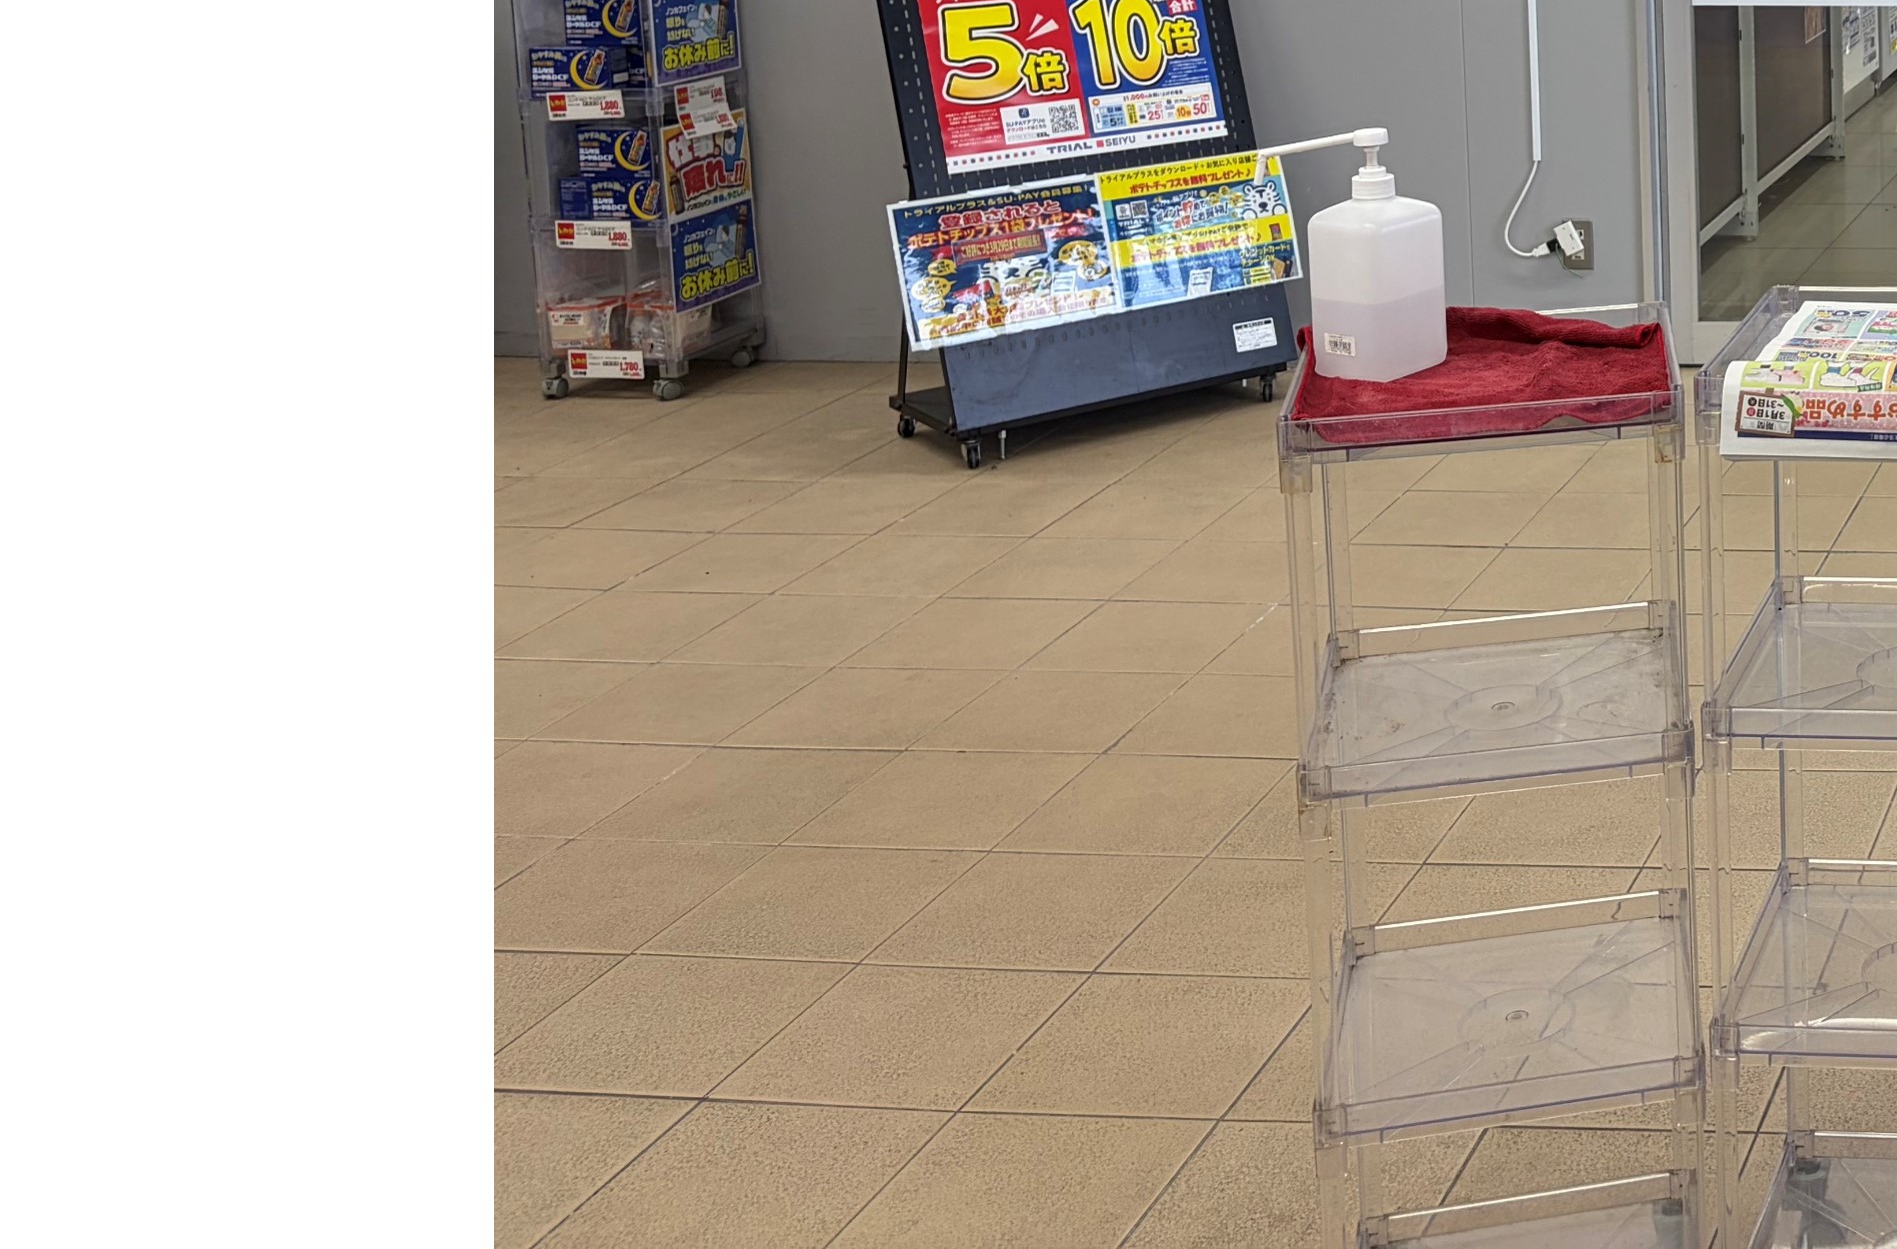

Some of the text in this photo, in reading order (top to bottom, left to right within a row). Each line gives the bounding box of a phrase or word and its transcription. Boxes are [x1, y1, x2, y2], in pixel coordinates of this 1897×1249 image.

[942, 2, 1067, 100] 5倍
[1046, 135, 1136, 154] TRIAL SEIYU
[939, 200, 1062, 230] 登録されると
[1756, 421, 1776, 430] 期間
